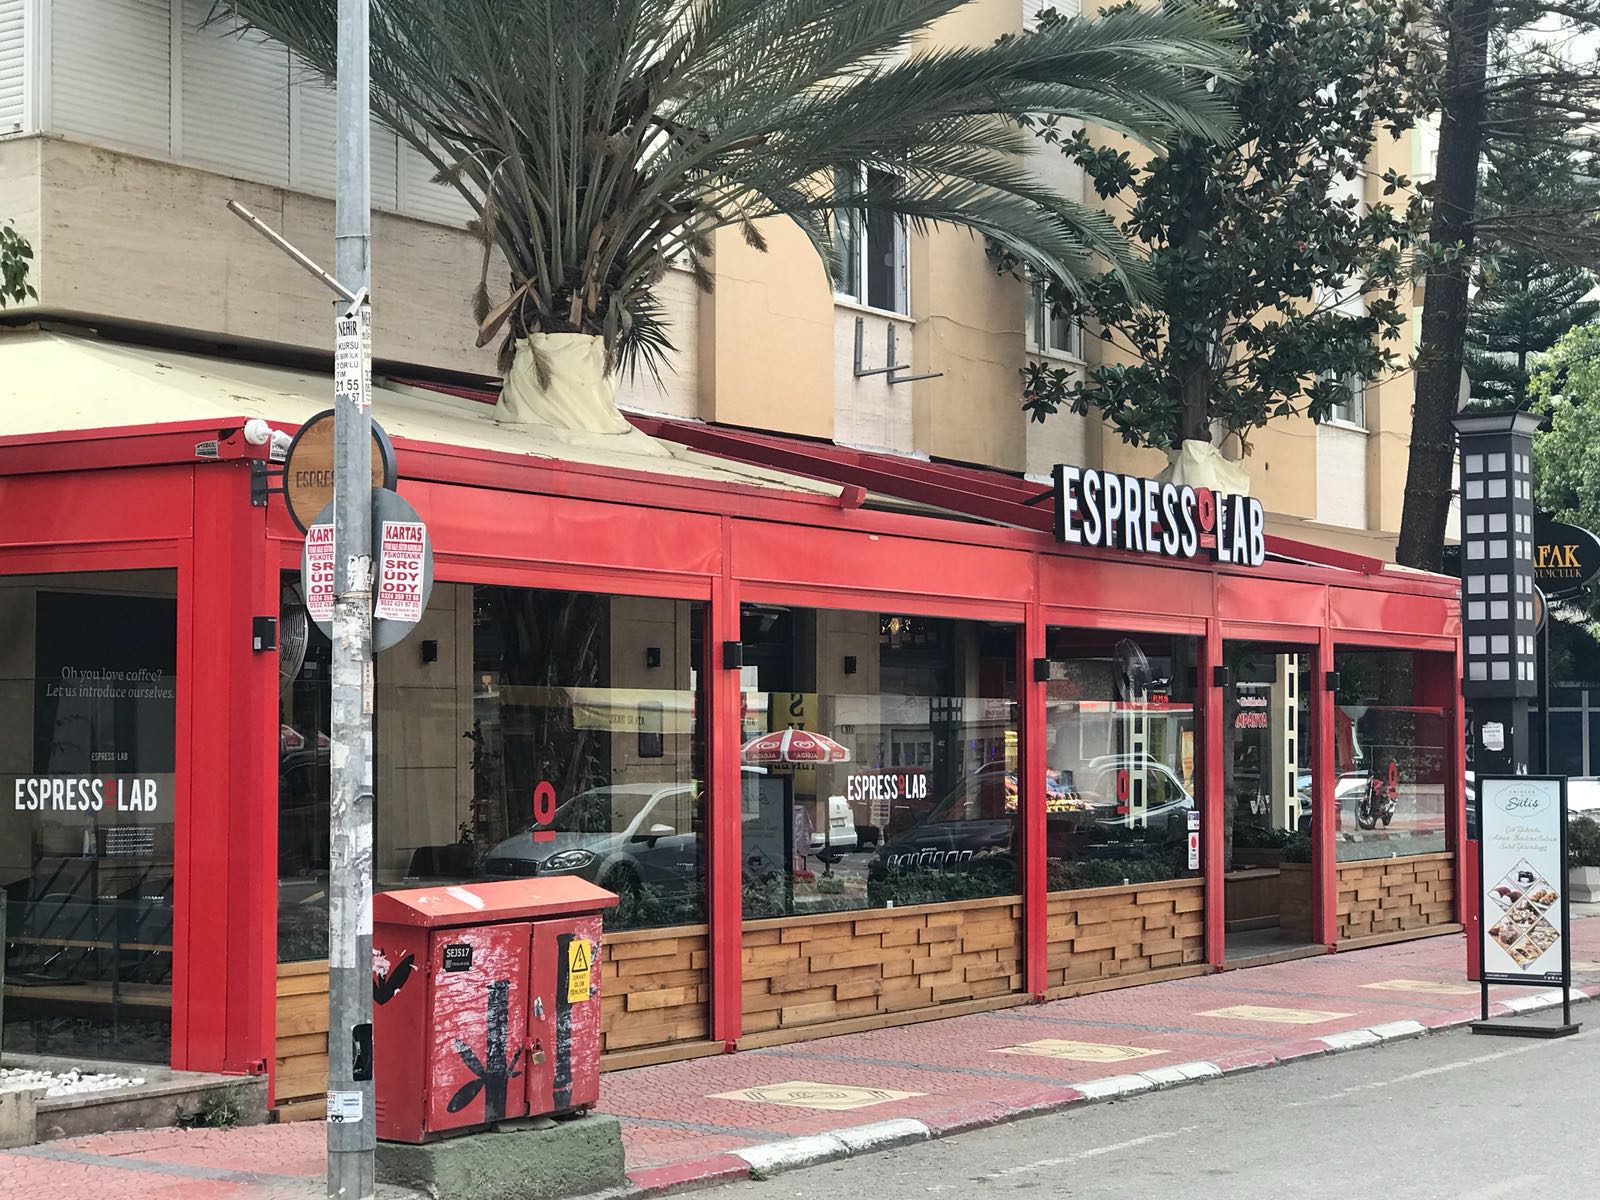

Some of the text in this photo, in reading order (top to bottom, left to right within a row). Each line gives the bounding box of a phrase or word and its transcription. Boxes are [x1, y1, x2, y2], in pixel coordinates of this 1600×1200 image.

[347, 379, 359, 391] 55
[1054, 464, 1266, 567] ESPRESSOLAB
[309, 528, 334, 542] KART
[311, 562, 334, 571] SR
[385, 559, 419, 570] SRC
[311, 571, 334, 583] ÜD
[384, 569, 419, 582] ÜDY
[311, 584, 334, 594] OD
[383, 582, 419, 593] ODY
[62, 666, 163, 683] Oh you love coffee?
[46, 684, 175, 699] Let us introduce ourselves.
[847, 774, 927, 801] ESPRESSOLAB
[15, 778, 158, 812] ESPRESSOLAB
[446, 947, 470, 958] SEJ517
